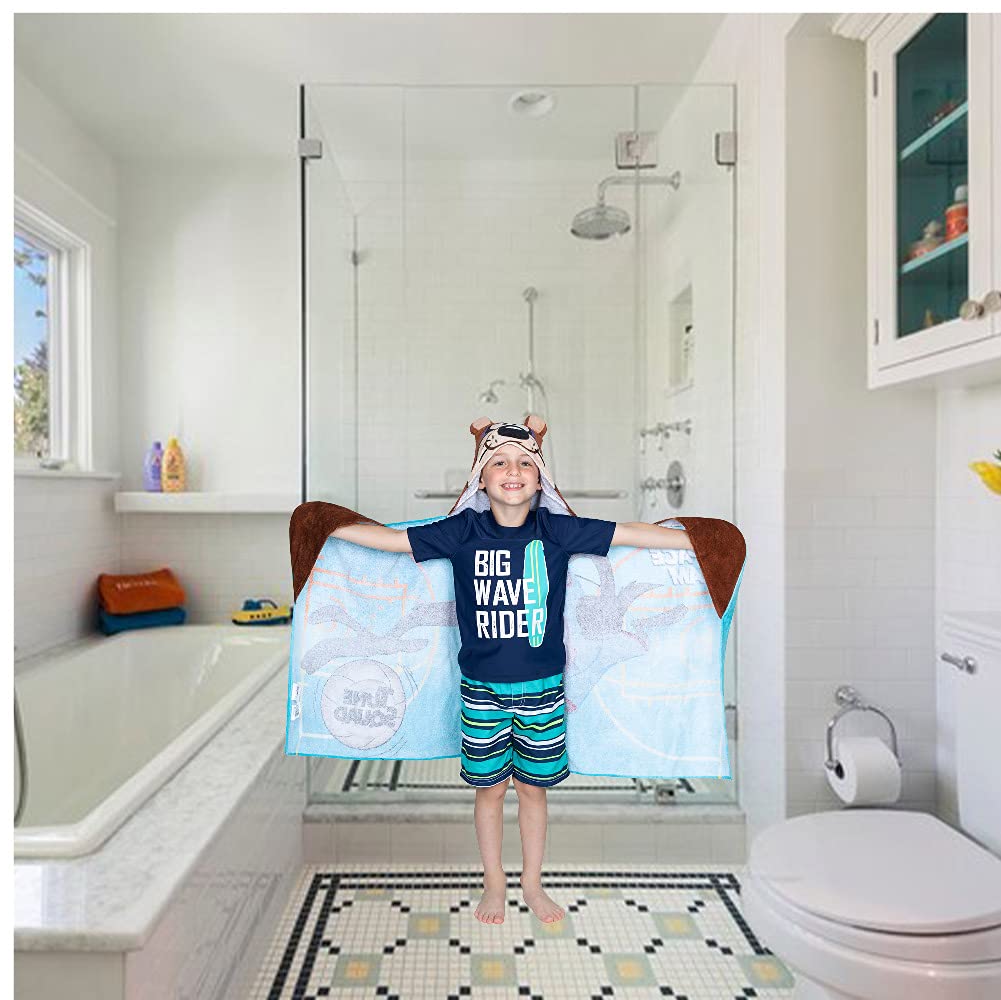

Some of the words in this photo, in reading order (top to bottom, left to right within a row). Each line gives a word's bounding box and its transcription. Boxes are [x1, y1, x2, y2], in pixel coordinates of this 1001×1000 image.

[474, 549, 511, 577] BIG
[473, 578, 537, 606] WAVE
[475, 607, 544, 639] RIDER
